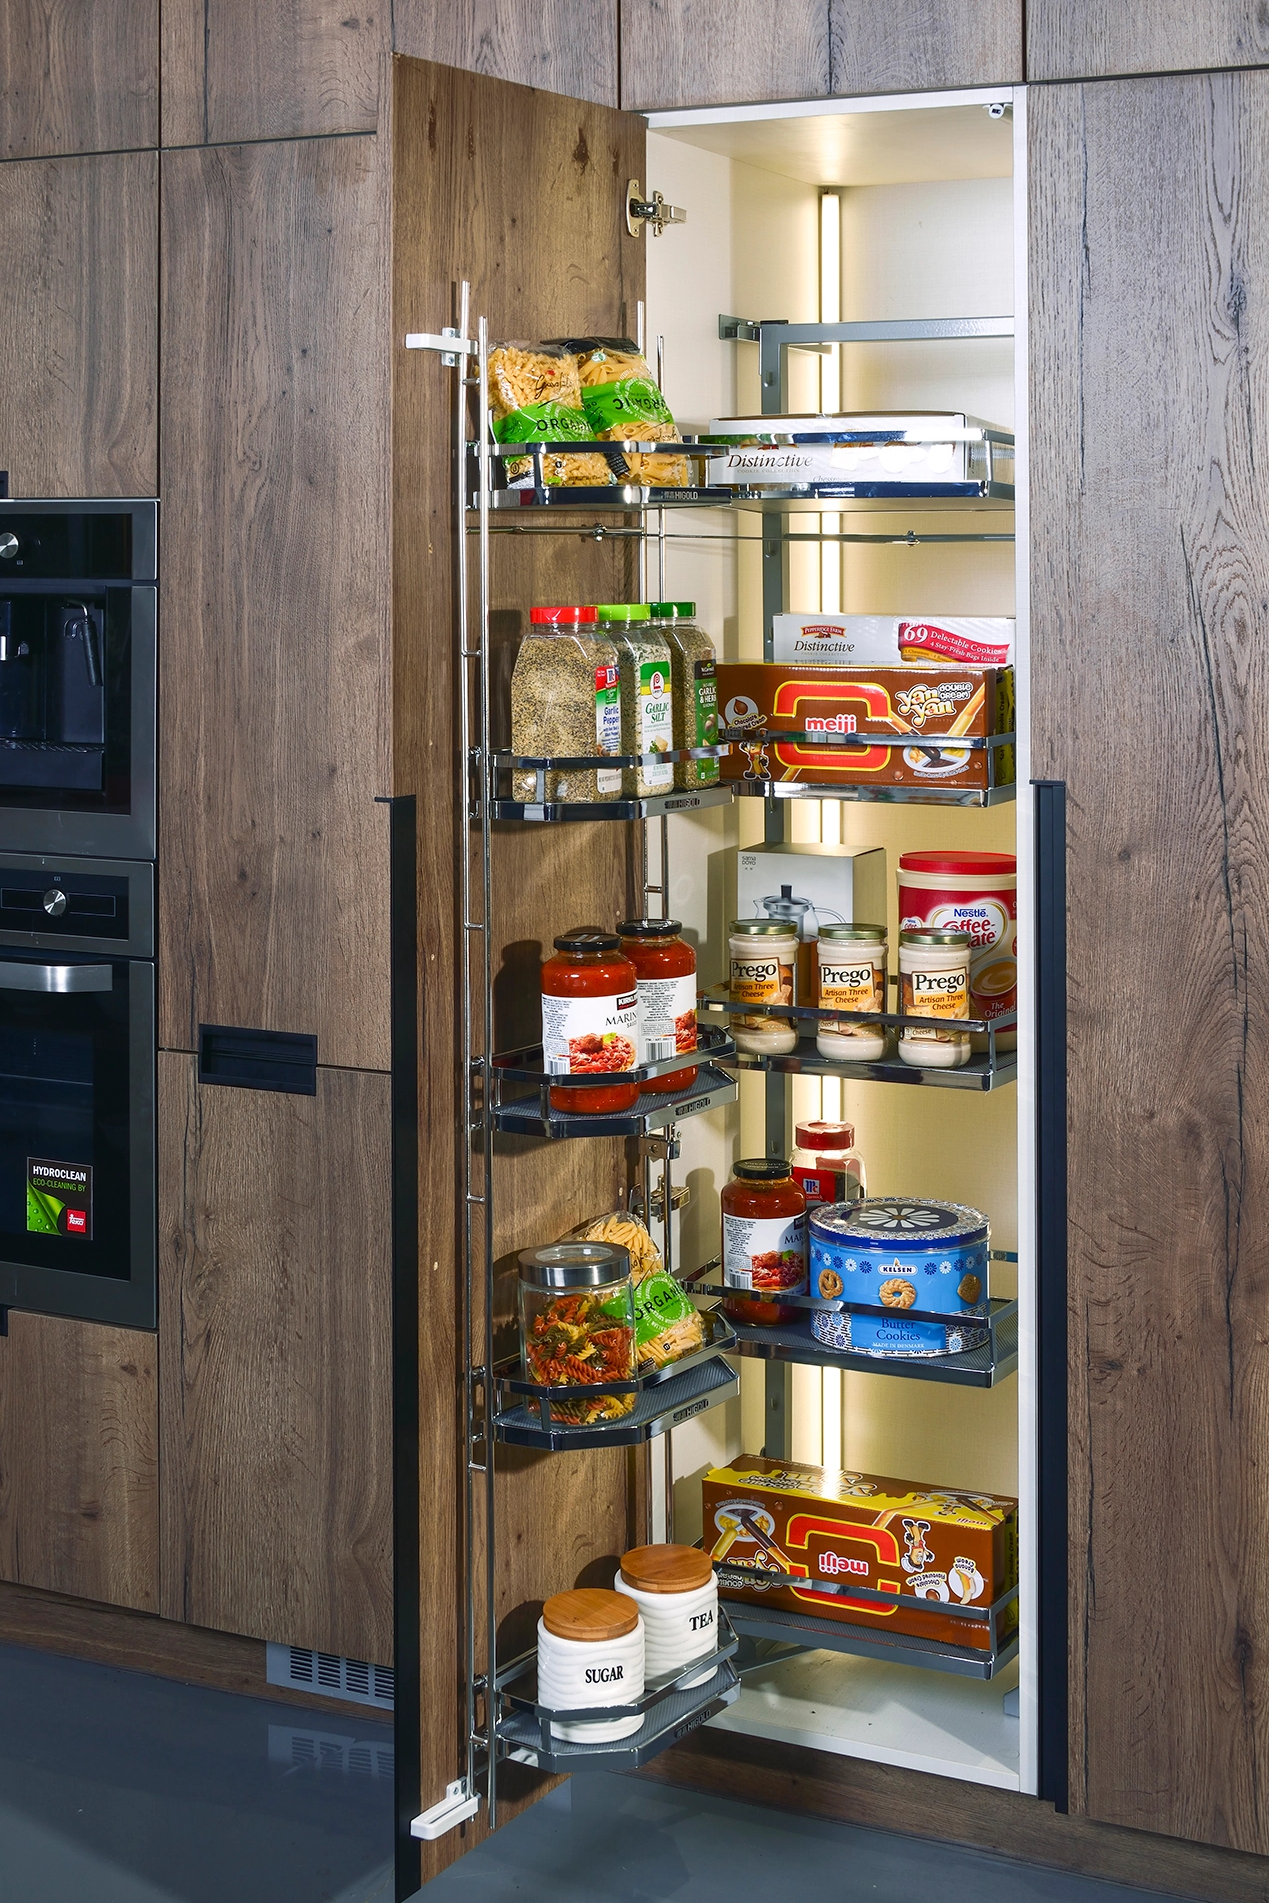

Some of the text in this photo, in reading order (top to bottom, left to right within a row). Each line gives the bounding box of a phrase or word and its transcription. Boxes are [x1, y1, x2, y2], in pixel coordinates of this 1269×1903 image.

[727, 454, 813, 468] Distinctive
[675, 491, 699, 500] HIGOLD
[904, 624, 928, 643] 69
[793, 640, 855, 652] Distinctive
[930, 631, 1007, 655] Delectable Cookies
[934, 642, 966, 656] Stay-Fresh
[966, 651, 980, 661] Bags
[604, 705, 619, 715] Garlic
[645, 702, 670, 715] GARLIC
[651, 712, 666, 724] SALT
[806, 715, 857, 733] meiji
[731, 961, 777, 982] Prego
[822, 967, 871, 988] Prego
[914, 974, 965, 994] Prego
[741, 990, 765, 998] Cheese
[848, 988, 869, 996] Three
[919, 993, 964, 1004] Artisan Three
[834, 996, 859, 1004] Cheese
[990, 1002, 1005, 1010] The
[932, 1003, 956, 1011] Cheese
[984, 1000, 1017, 1018] Original
[33, 1165, 86, 1182] HYDROCLEAN
[33, 1178, 86, 1192] ECO-CLEANING BY
[883, 1265, 913, 1273] KELSEN
[881, 1318, 915, 1329] Butter
[876, 1329, 921, 1341] Cookies
[819, 1552, 868, 1575] meiji
[689, 1609, 714, 1632] TEA
[585, 1665, 624, 1684] SUGAR
